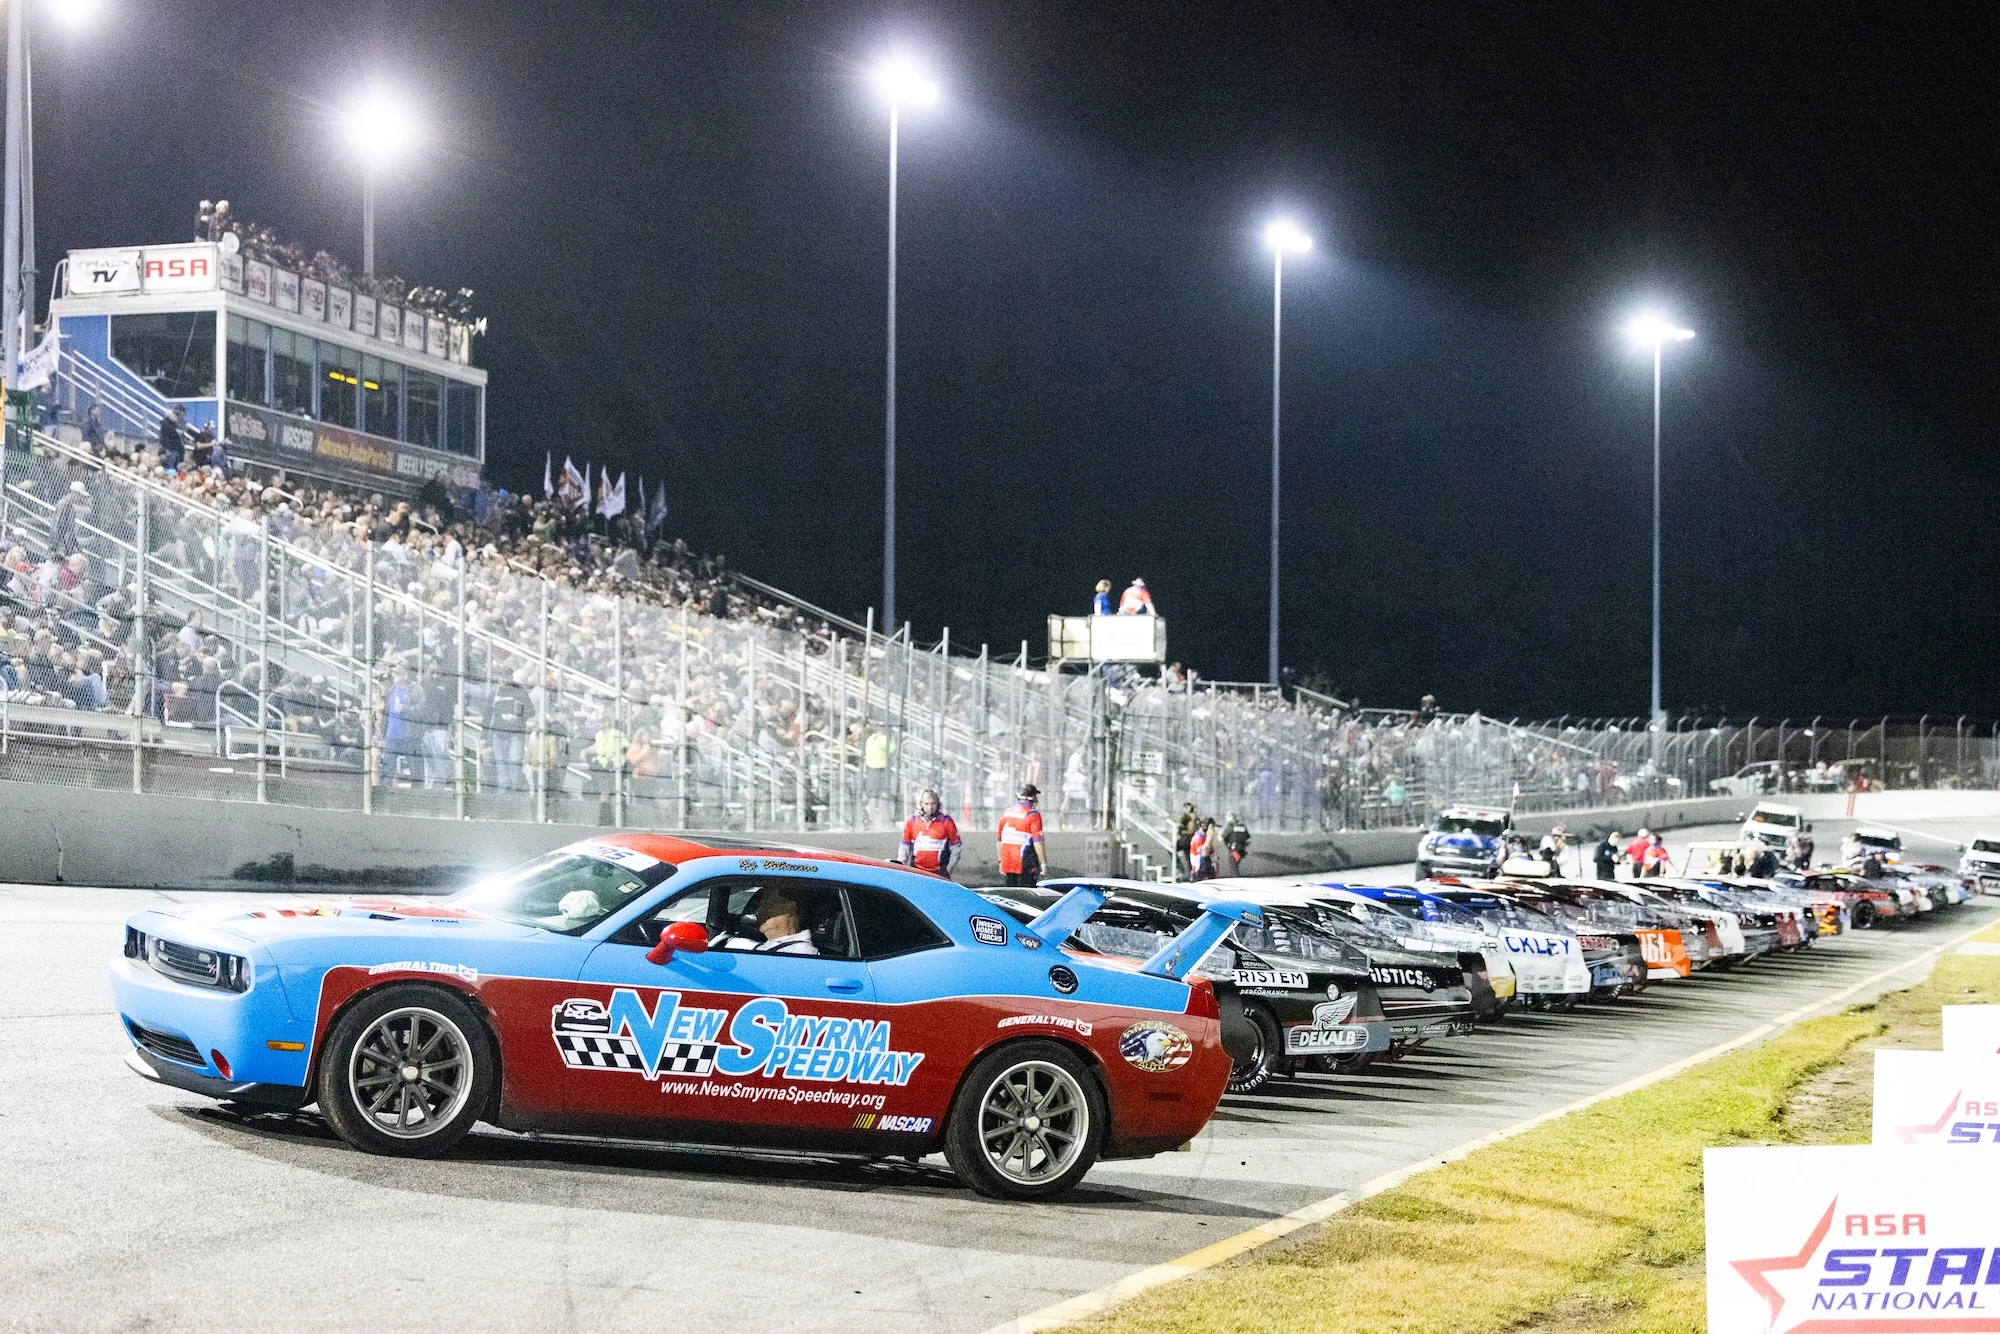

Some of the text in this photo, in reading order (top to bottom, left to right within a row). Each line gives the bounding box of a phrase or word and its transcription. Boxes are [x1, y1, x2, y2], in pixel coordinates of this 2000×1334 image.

[145, 258, 208, 278] ASA
[93, 270, 118, 284] TV
[976, 925, 995, 935] HOME
[977, 918, 1003, 930] NASCAR
[978, 932, 1003, 943] TRACKS
[1239, 988, 1289, 997] PERFORMANCE
[608, 989, 892, 1080] NEW SMYRNA
[1299, 1030, 1357, 1047] DEKALB
[1137, 1061, 1167, 1071] AUTO
[660, 1080, 887, 1110] www.NewSmyrnaSpeedway.org
[876, 1114, 934, 1133] NASCAR
[1845, 1213, 1926, 1236] ASA
[1811, 1291, 1986, 1311] NATIONAL
